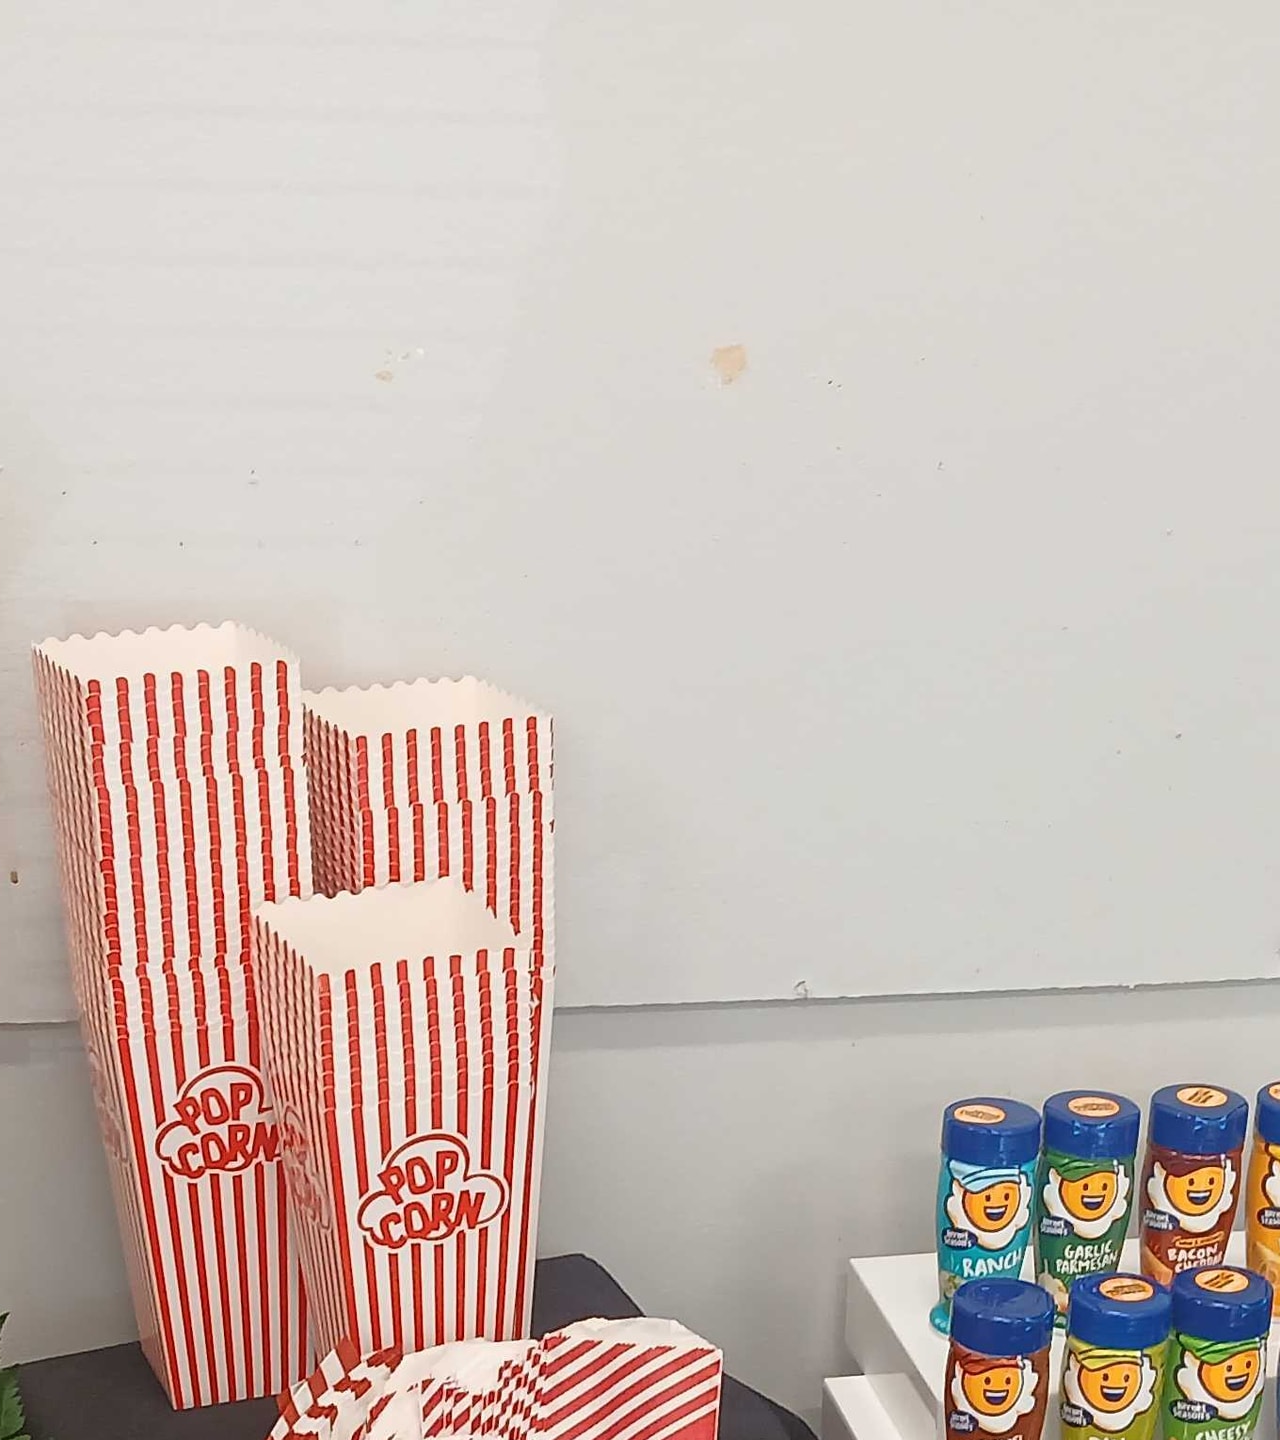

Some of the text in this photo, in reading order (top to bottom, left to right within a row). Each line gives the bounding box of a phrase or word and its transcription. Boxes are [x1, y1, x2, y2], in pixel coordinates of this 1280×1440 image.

[173, 1083, 253, 1135] POP
[177, 1122, 286, 1178] CORN
[378, 1151, 458, 1204] POP
[379, 1190, 485, 1248] CORN
[963, 1248, 1022, 1278] RANCH
[1056, 1251, 1118, 1274] PARMESAN
[1065, 1240, 1112, 1258] GARLIC
[1167, 1243, 1218, 1261] BACON
